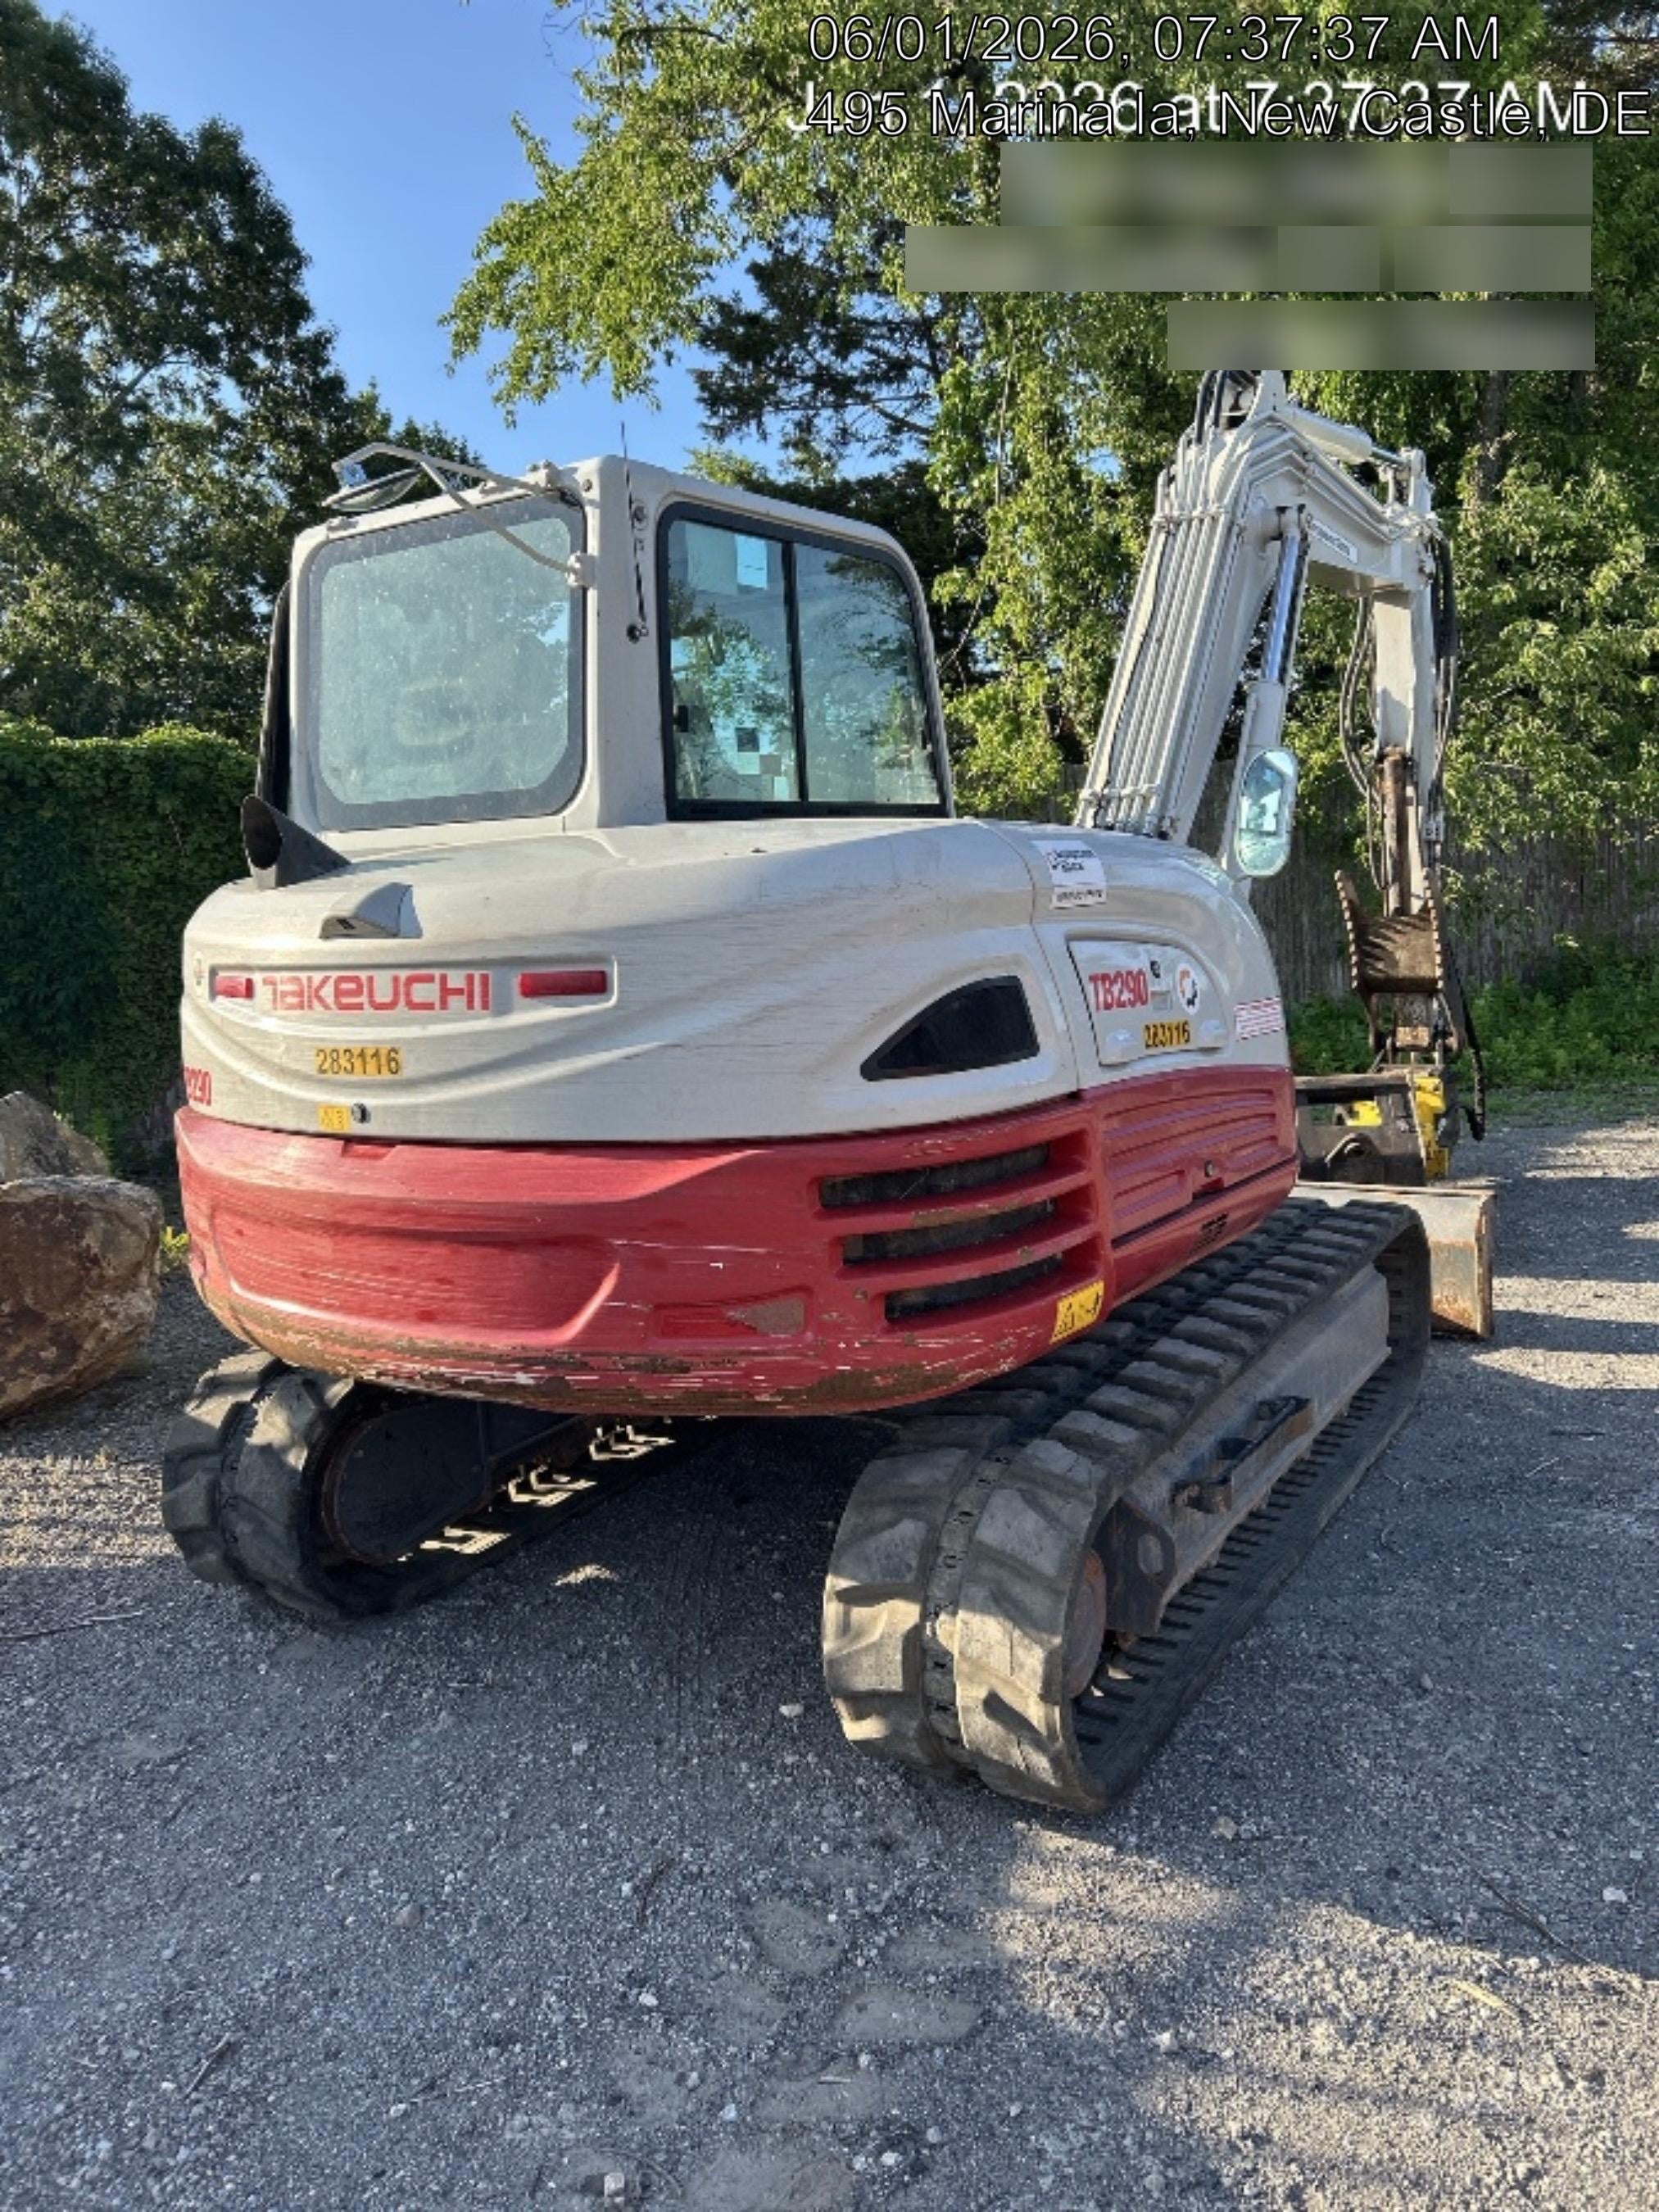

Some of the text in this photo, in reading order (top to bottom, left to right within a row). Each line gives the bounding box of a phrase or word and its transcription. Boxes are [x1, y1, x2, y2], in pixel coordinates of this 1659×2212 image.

[259, 972, 492, 1011] TAKEUCHI
[1089, 968, 1149, 1012] TB290
[315, 1047, 401, 1077] 283116
